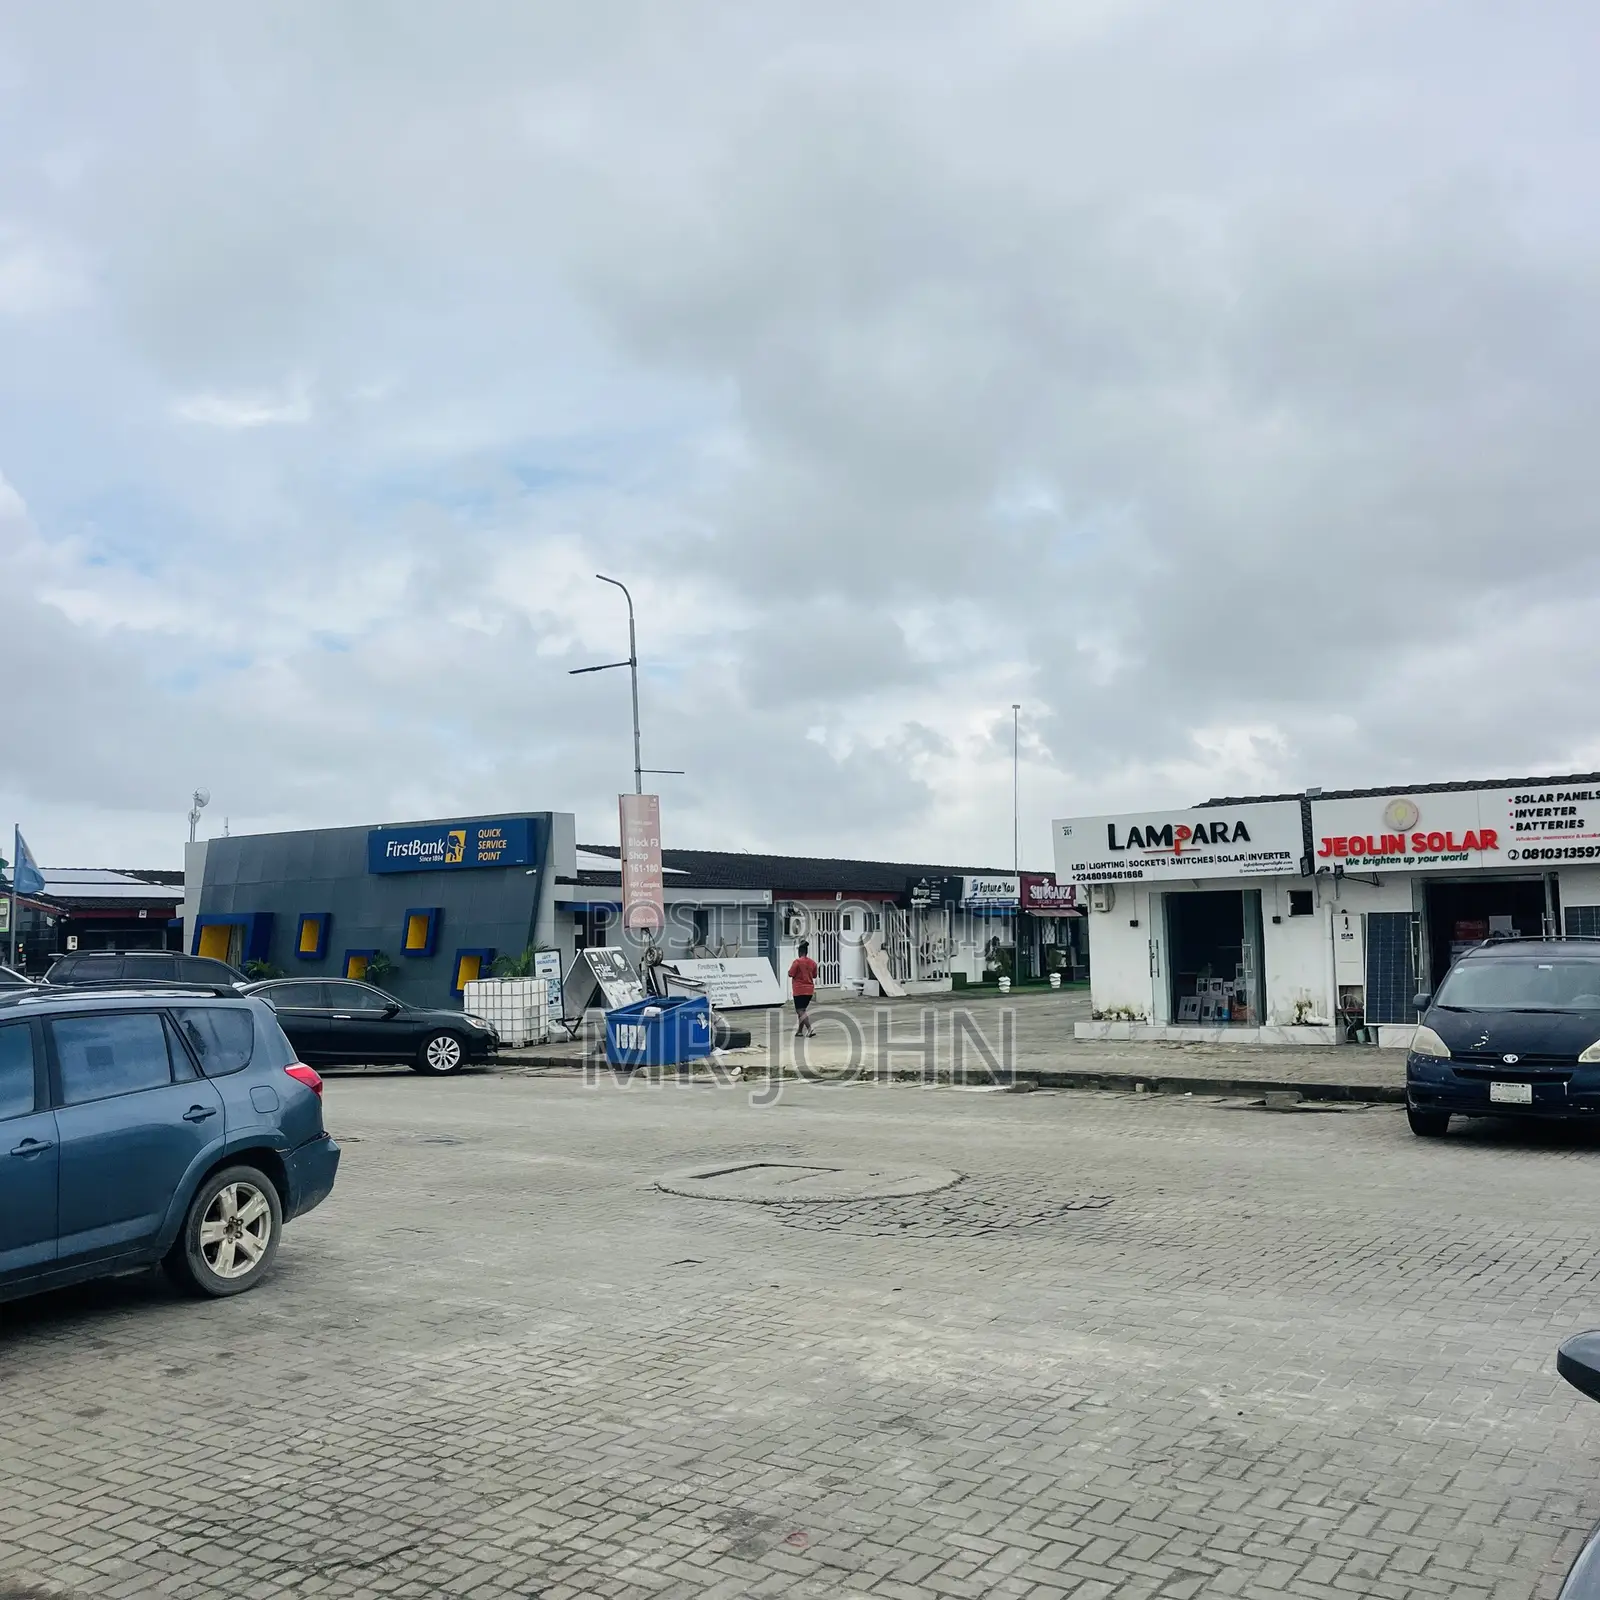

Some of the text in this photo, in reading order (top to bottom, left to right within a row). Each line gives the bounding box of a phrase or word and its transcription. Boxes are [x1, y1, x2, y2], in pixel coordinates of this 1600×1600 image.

[1514, 790, 1600, 804] SOLAR PANELS
[1514, 806, 1577, 818] INVERTER
[1515, 819, 1585, 831] BATTERIES
[478, 828, 501, 838] QUICK
[1107, 820, 1251, 856] LAMPARA
[386, 838, 446, 857] FirstBank
[477, 840, 507, 850] SERVICE
[628, 837, 659, 847] Block F3
[1317, 829, 1499, 857] JEOLIN SOLAR
[478, 851, 501, 861] POINT
[628, 850, 649, 862] Shop
[1089, 861, 1125, 869] LIGHTING
[1129, 859, 1166, 867] SOCKETS
[1170, 857, 1214, 865] SWITCHES
[1216, 854, 1245, 862] SOLAR
[1248, 852, 1291, 860] INVERTER
[1345, 852, 1469, 867] We brighten up your world
[979, 882, 1001, 893] Future
[1002, 881, 1015, 893] You
